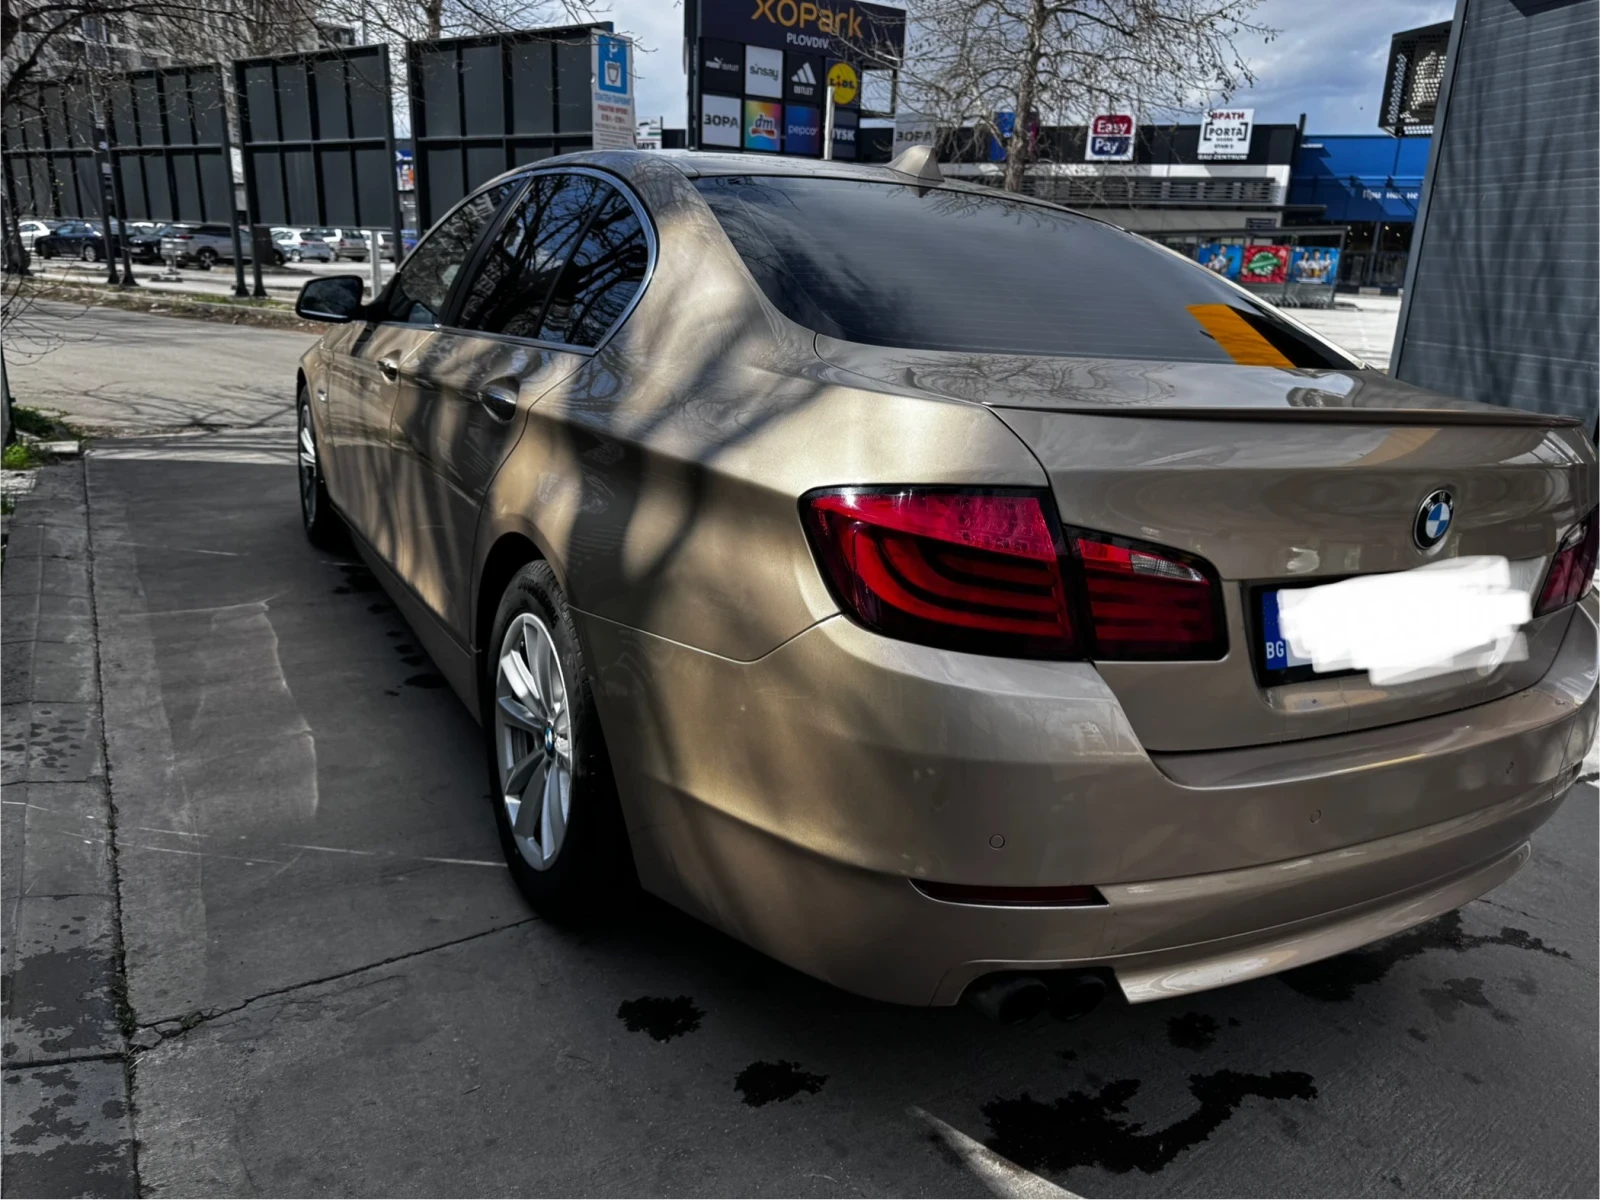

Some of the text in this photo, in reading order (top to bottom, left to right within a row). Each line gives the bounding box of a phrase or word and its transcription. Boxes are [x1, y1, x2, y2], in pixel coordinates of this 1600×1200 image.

[786, 32, 830, 49] PLOVDIV
[749, 63, 778, 81] sinsay
[793, 85, 814, 96] OUTLET
[704, 113, 738, 128] ЗОРА
[754, 115, 774, 129] dm
[1097, 119, 1128, 135] Easy
[788, 123, 816, 136] pepco
[1209, 127, 1243, 137] PORTA
[1095, 137, 1119, 155] Pay
[1266, 641, 1285, 659] BG
